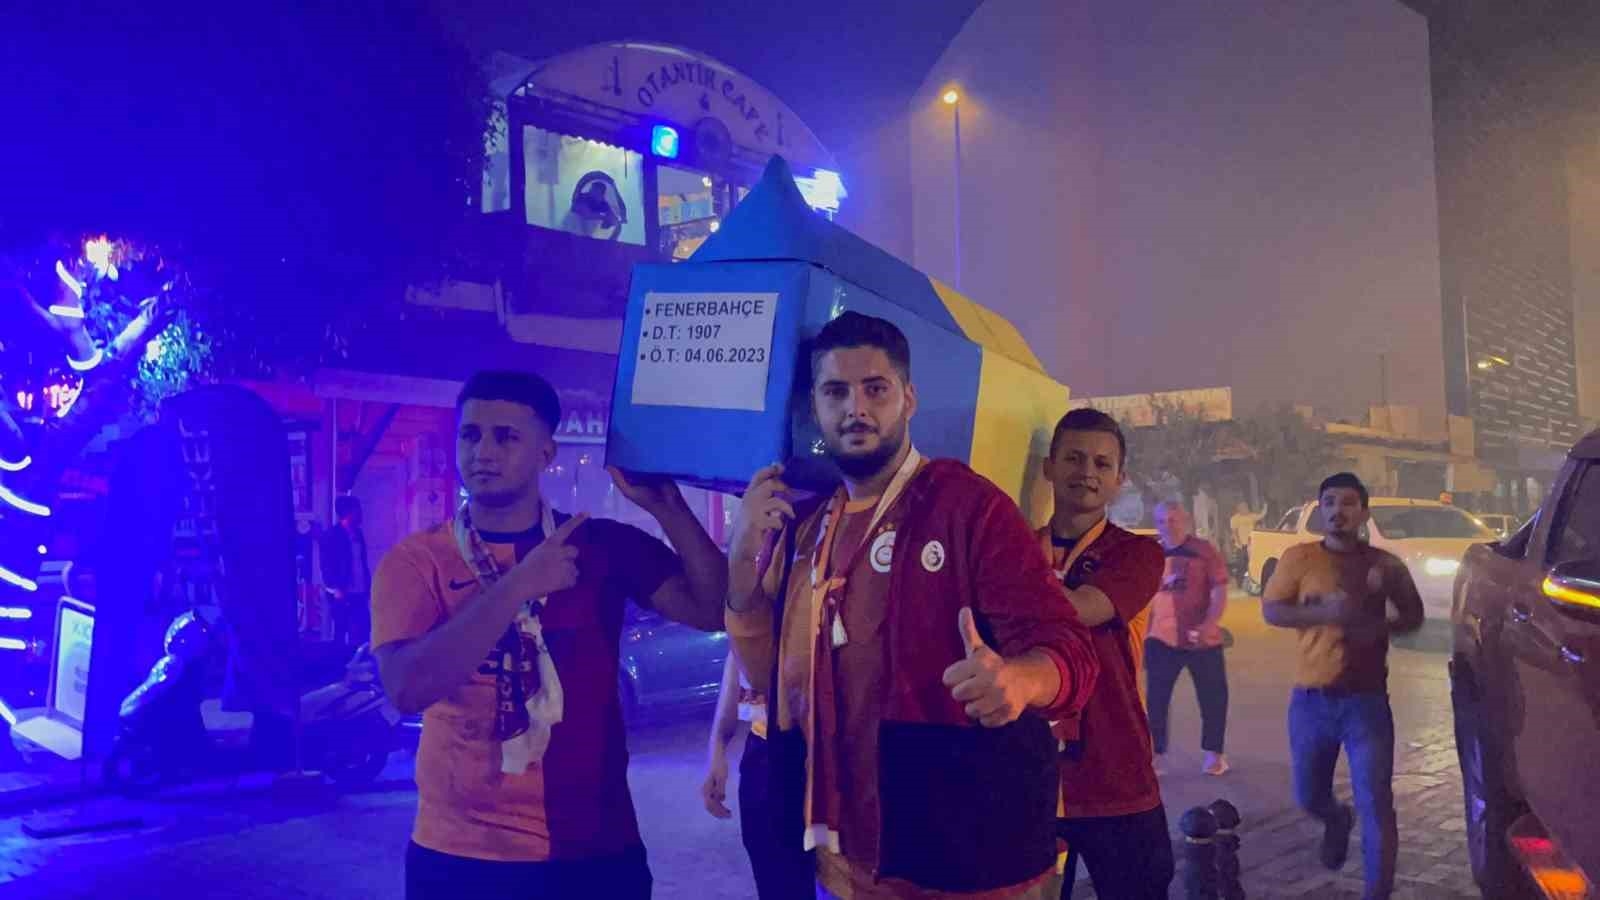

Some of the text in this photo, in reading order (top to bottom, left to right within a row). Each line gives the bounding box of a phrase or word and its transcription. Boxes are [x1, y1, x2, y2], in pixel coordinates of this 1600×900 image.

[655, 299, 765, 319] FENERBAHÇE
[652, 324, 721, 340] D.T: 1907
[650, 345, 766, 363] Ö.T: 04.06.2023
